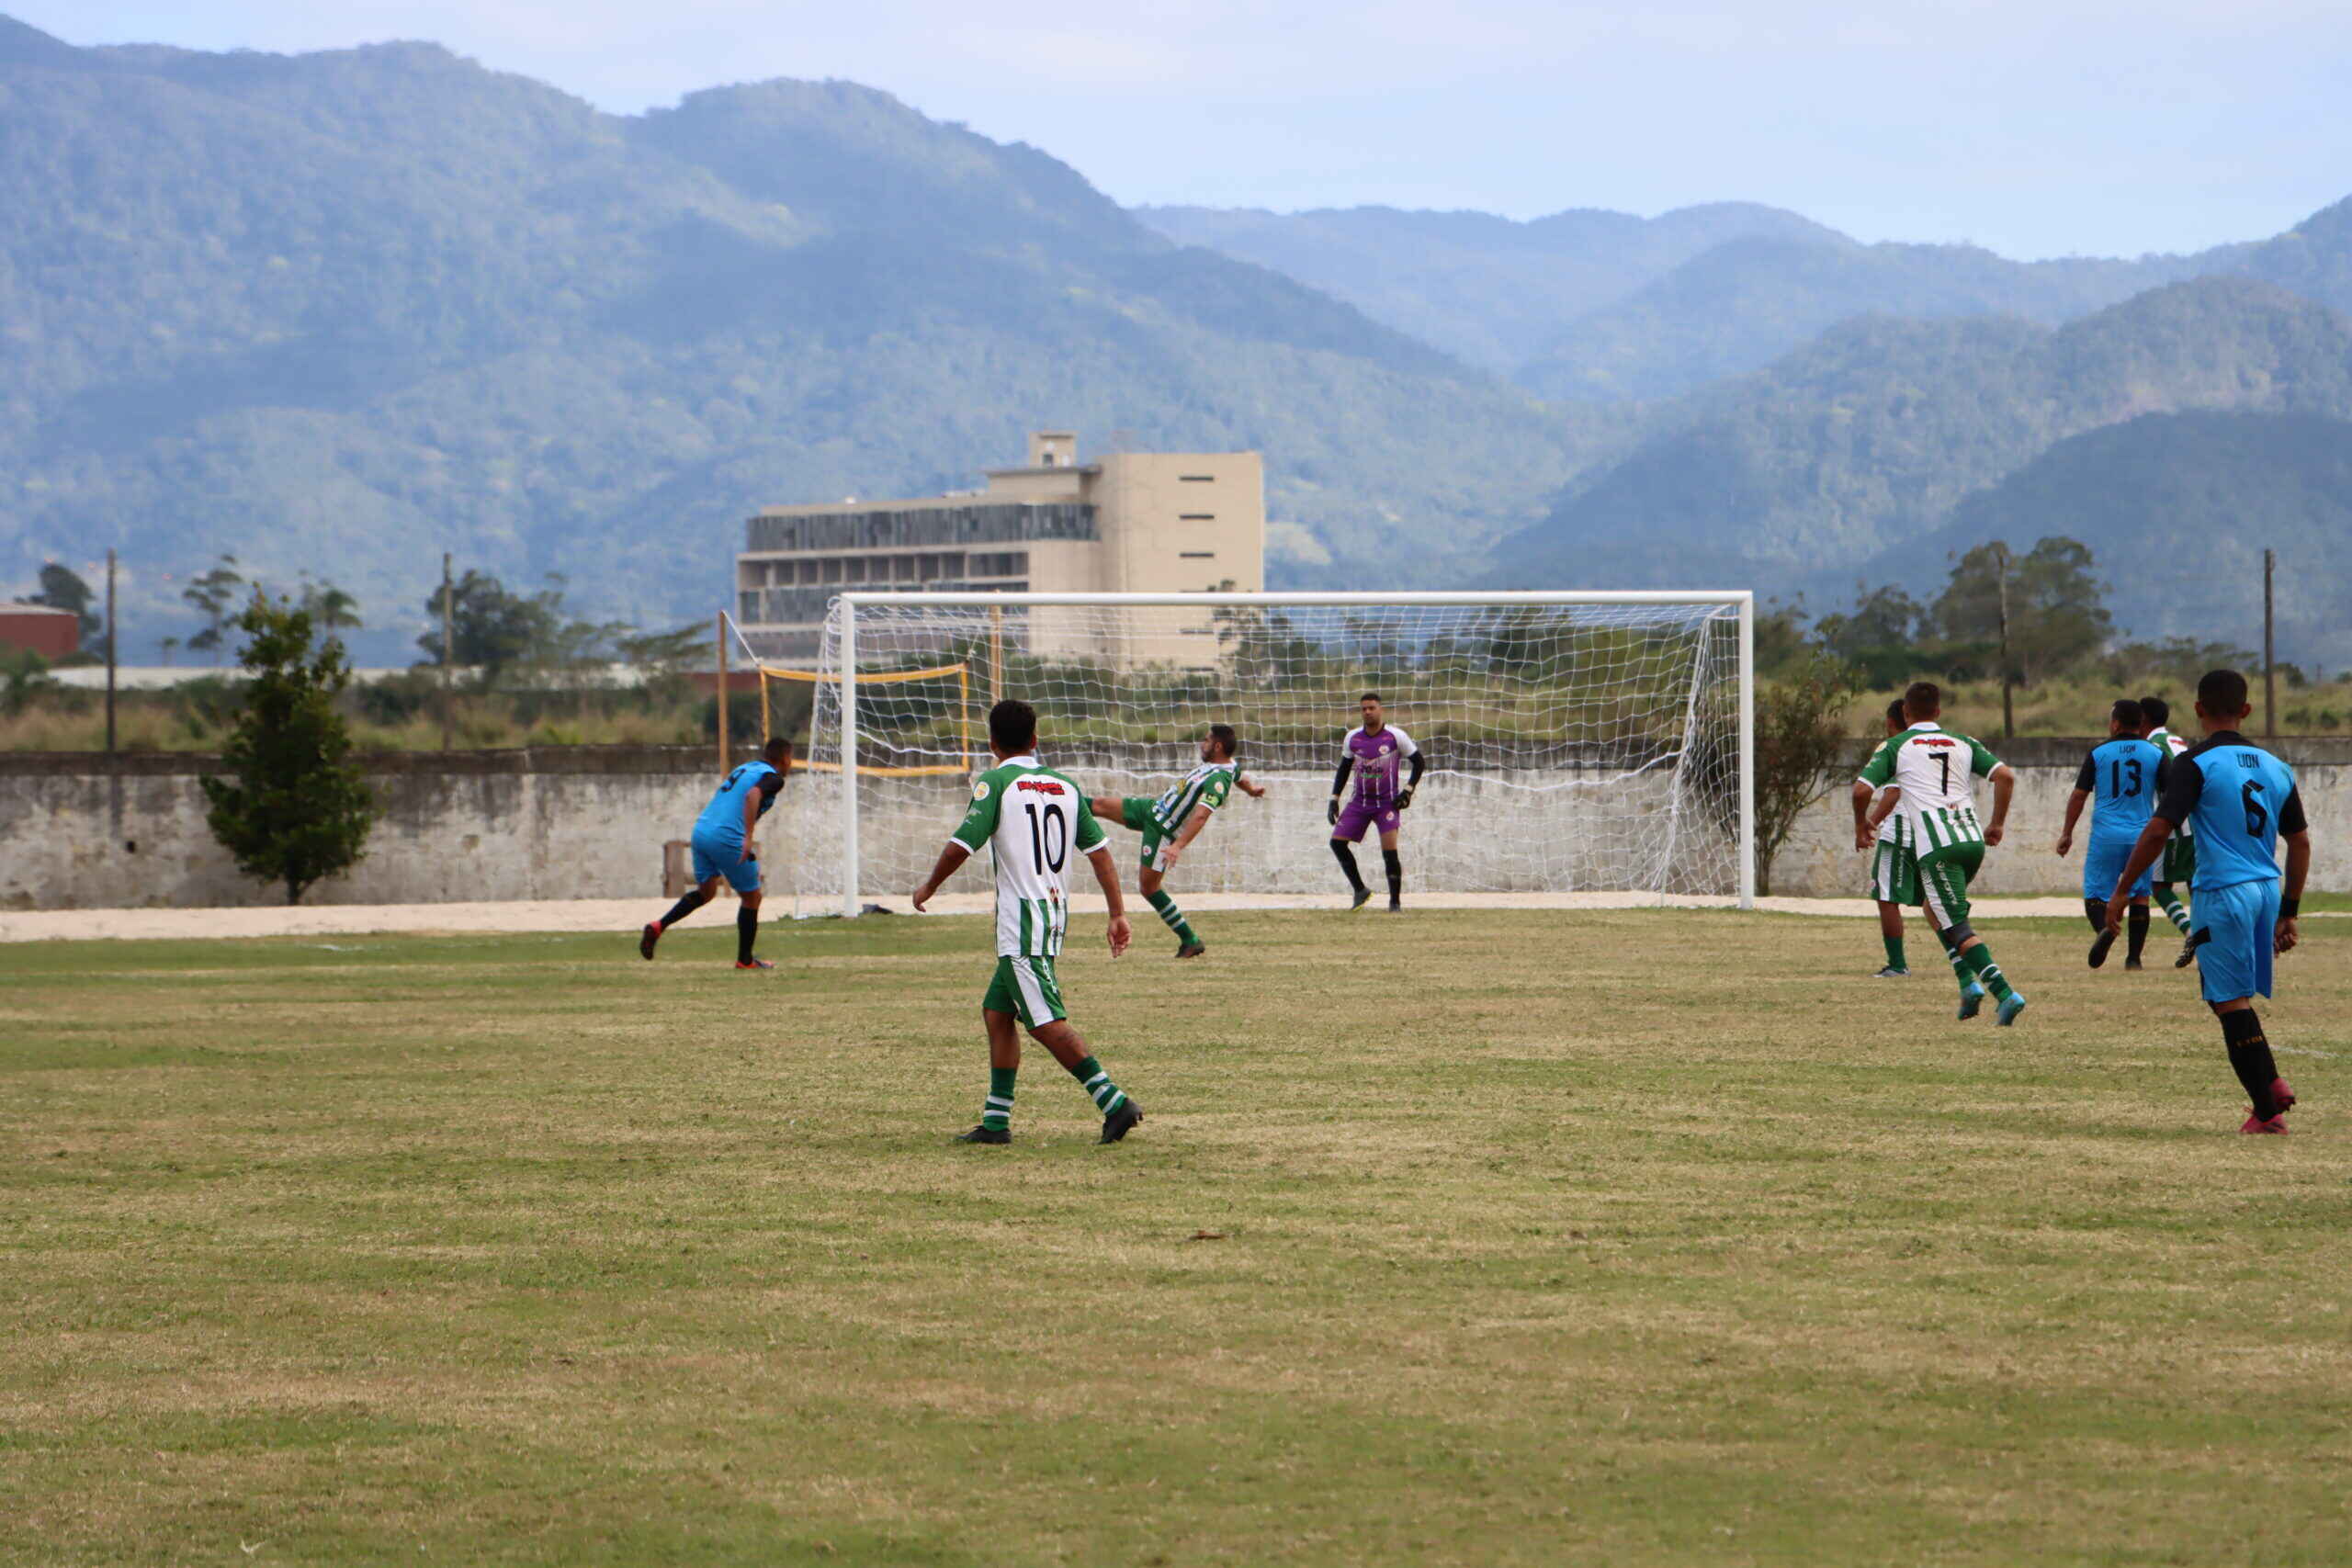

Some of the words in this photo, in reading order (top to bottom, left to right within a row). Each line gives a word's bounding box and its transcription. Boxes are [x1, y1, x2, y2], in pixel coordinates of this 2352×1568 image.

[1928, 752, 1949, 796] 7
[2112, 758, 2142, 798] 13
[2236, 753, 2259, 768] LION
[2242, 779, 2267, 838] 6
[1025, 804, 1067, 875] 10
